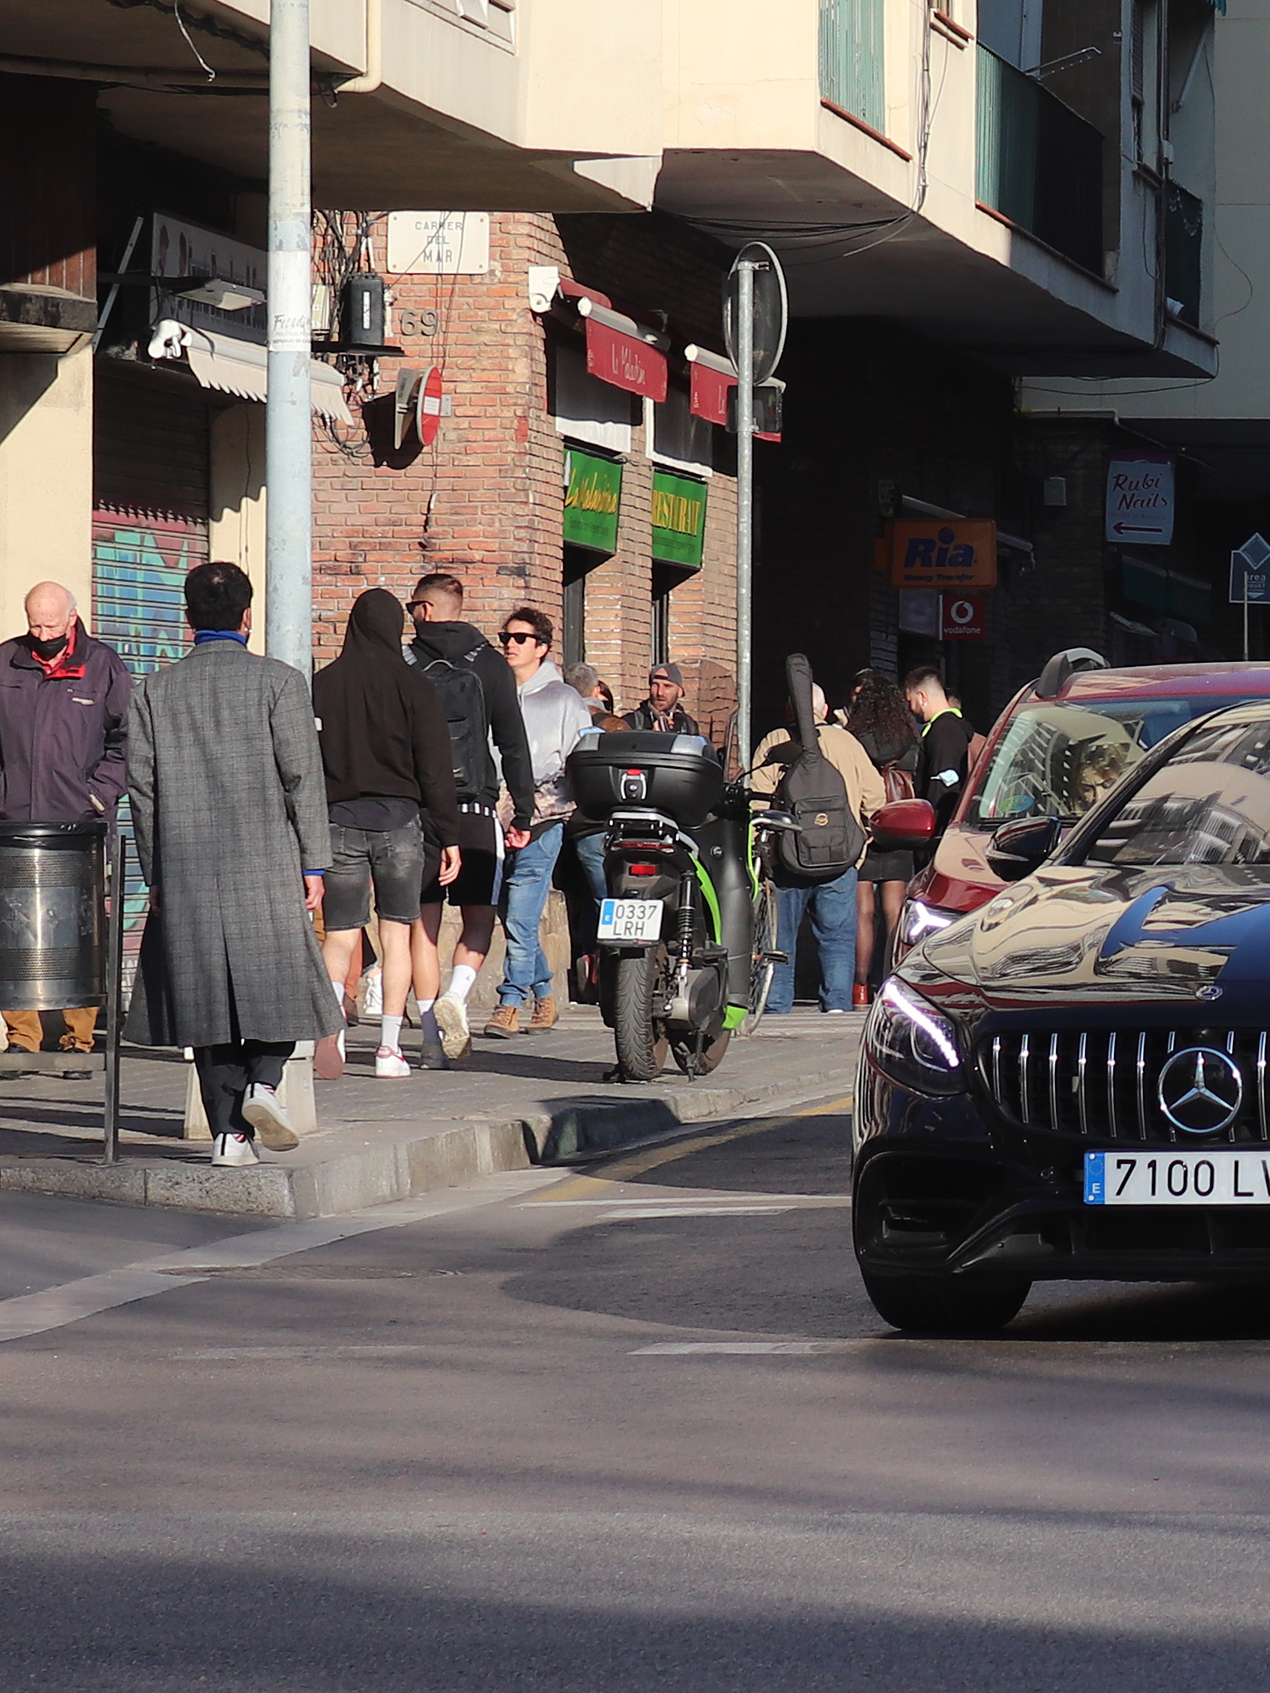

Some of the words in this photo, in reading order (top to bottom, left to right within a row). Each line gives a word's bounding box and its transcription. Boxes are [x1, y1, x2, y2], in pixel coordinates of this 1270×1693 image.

[414, 221, 463, 230] CARRER
[427, 236, 450, 244] DEL
[423, 249, 453, 262] MAR
[400, 309, 438, 336] 69
[564, 468, 579, 509] La
[1112, 472, 1163, 492] Rubi
[1117, 493, 1168, 511] Nails
[903, 526, 975, 568] Ria
[903, 574, 934, 582] Money
[936, 574, 975, 582] Transfer
[943, 626, 981, 634] vodafone
[615, 904, 658, 920] 0337
[613, 920, 646, 936] LRH
[1115, 1159, 1216, 1197] 7100
[1092, 1183, 1101, 1194] E
